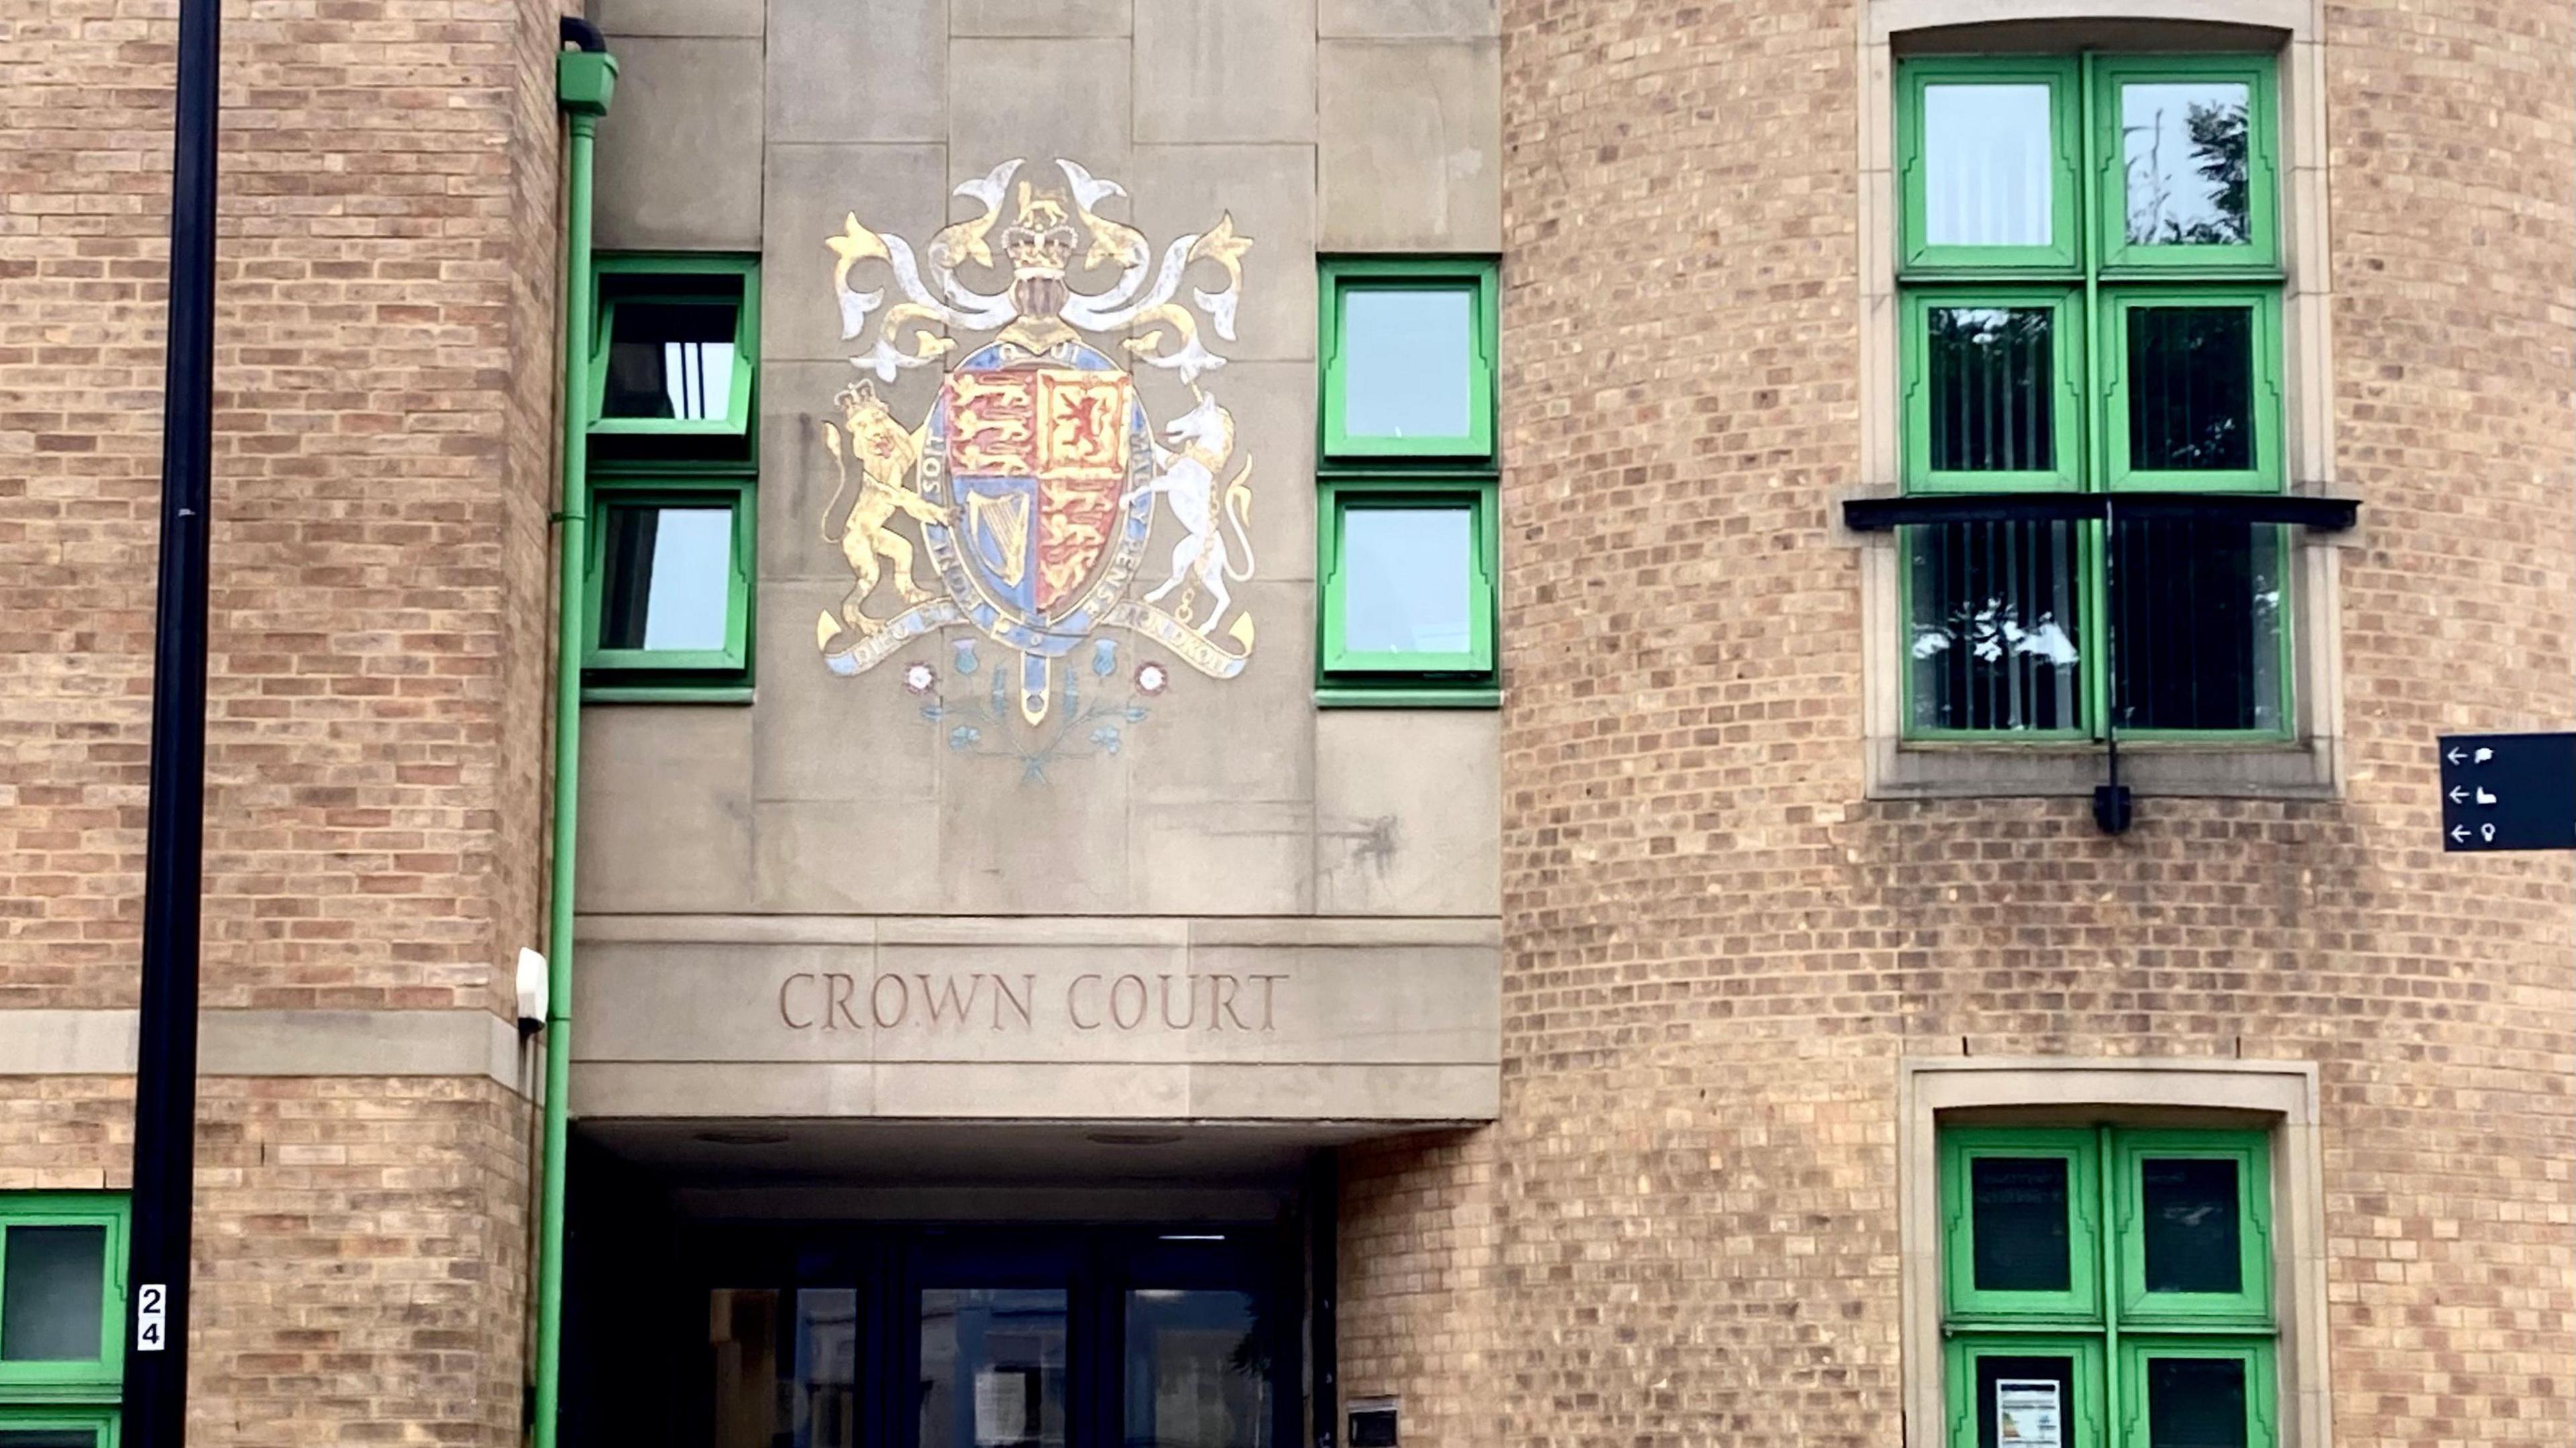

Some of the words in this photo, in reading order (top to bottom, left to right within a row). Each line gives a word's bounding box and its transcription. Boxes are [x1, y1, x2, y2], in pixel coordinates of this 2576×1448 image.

[922, 428, 945, 495] SOIT
[999, 341, 1079, 364] QUI
[779, 972, 1036, 1032] CROWN
[1067, 972, 1291, 1033] COURT
